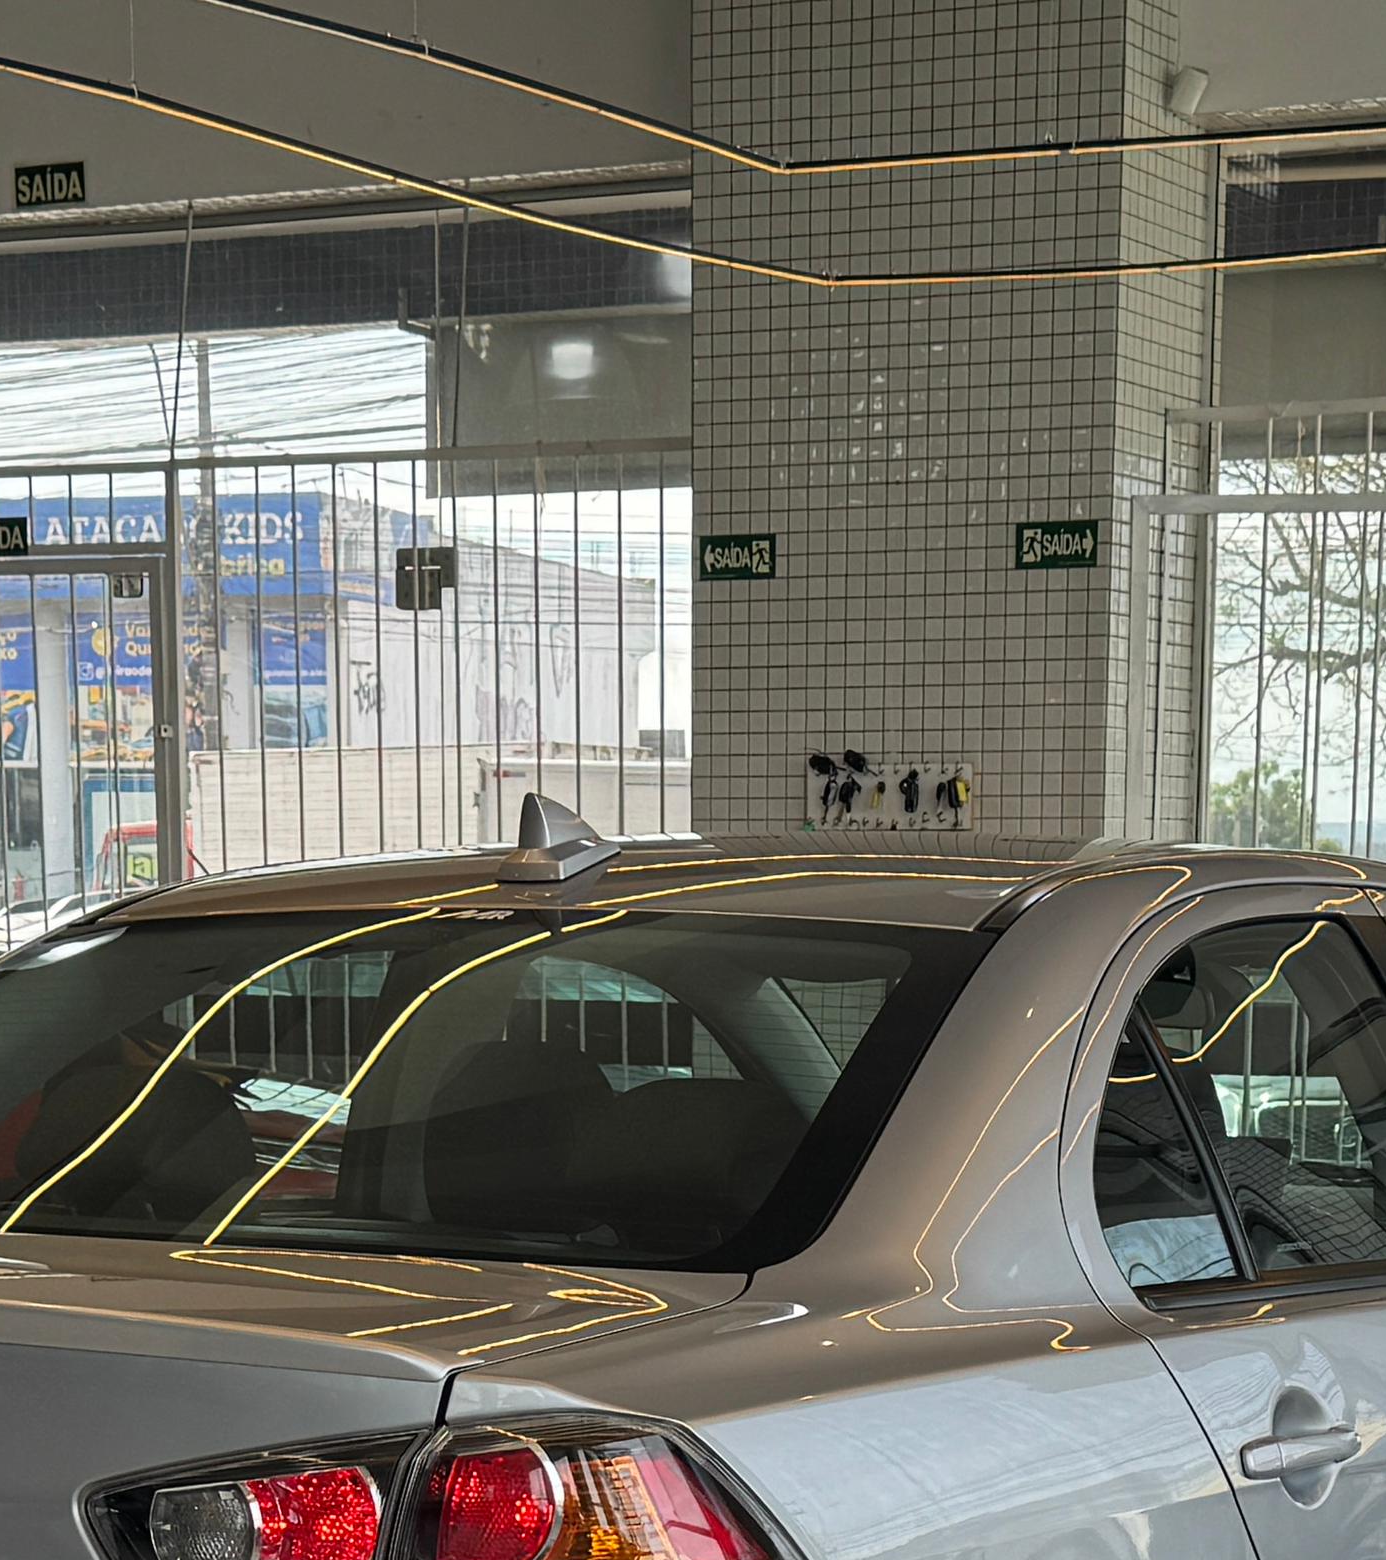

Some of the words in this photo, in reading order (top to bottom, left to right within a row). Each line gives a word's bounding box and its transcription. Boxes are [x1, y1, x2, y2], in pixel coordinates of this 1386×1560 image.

[17, 166, 83, 204] SAÍDA
[221, 511, 303, 546] KIDS
[1042, 527, 1083, 556] SAÍDA
[713, 541, 752, 570] SAÍDA
